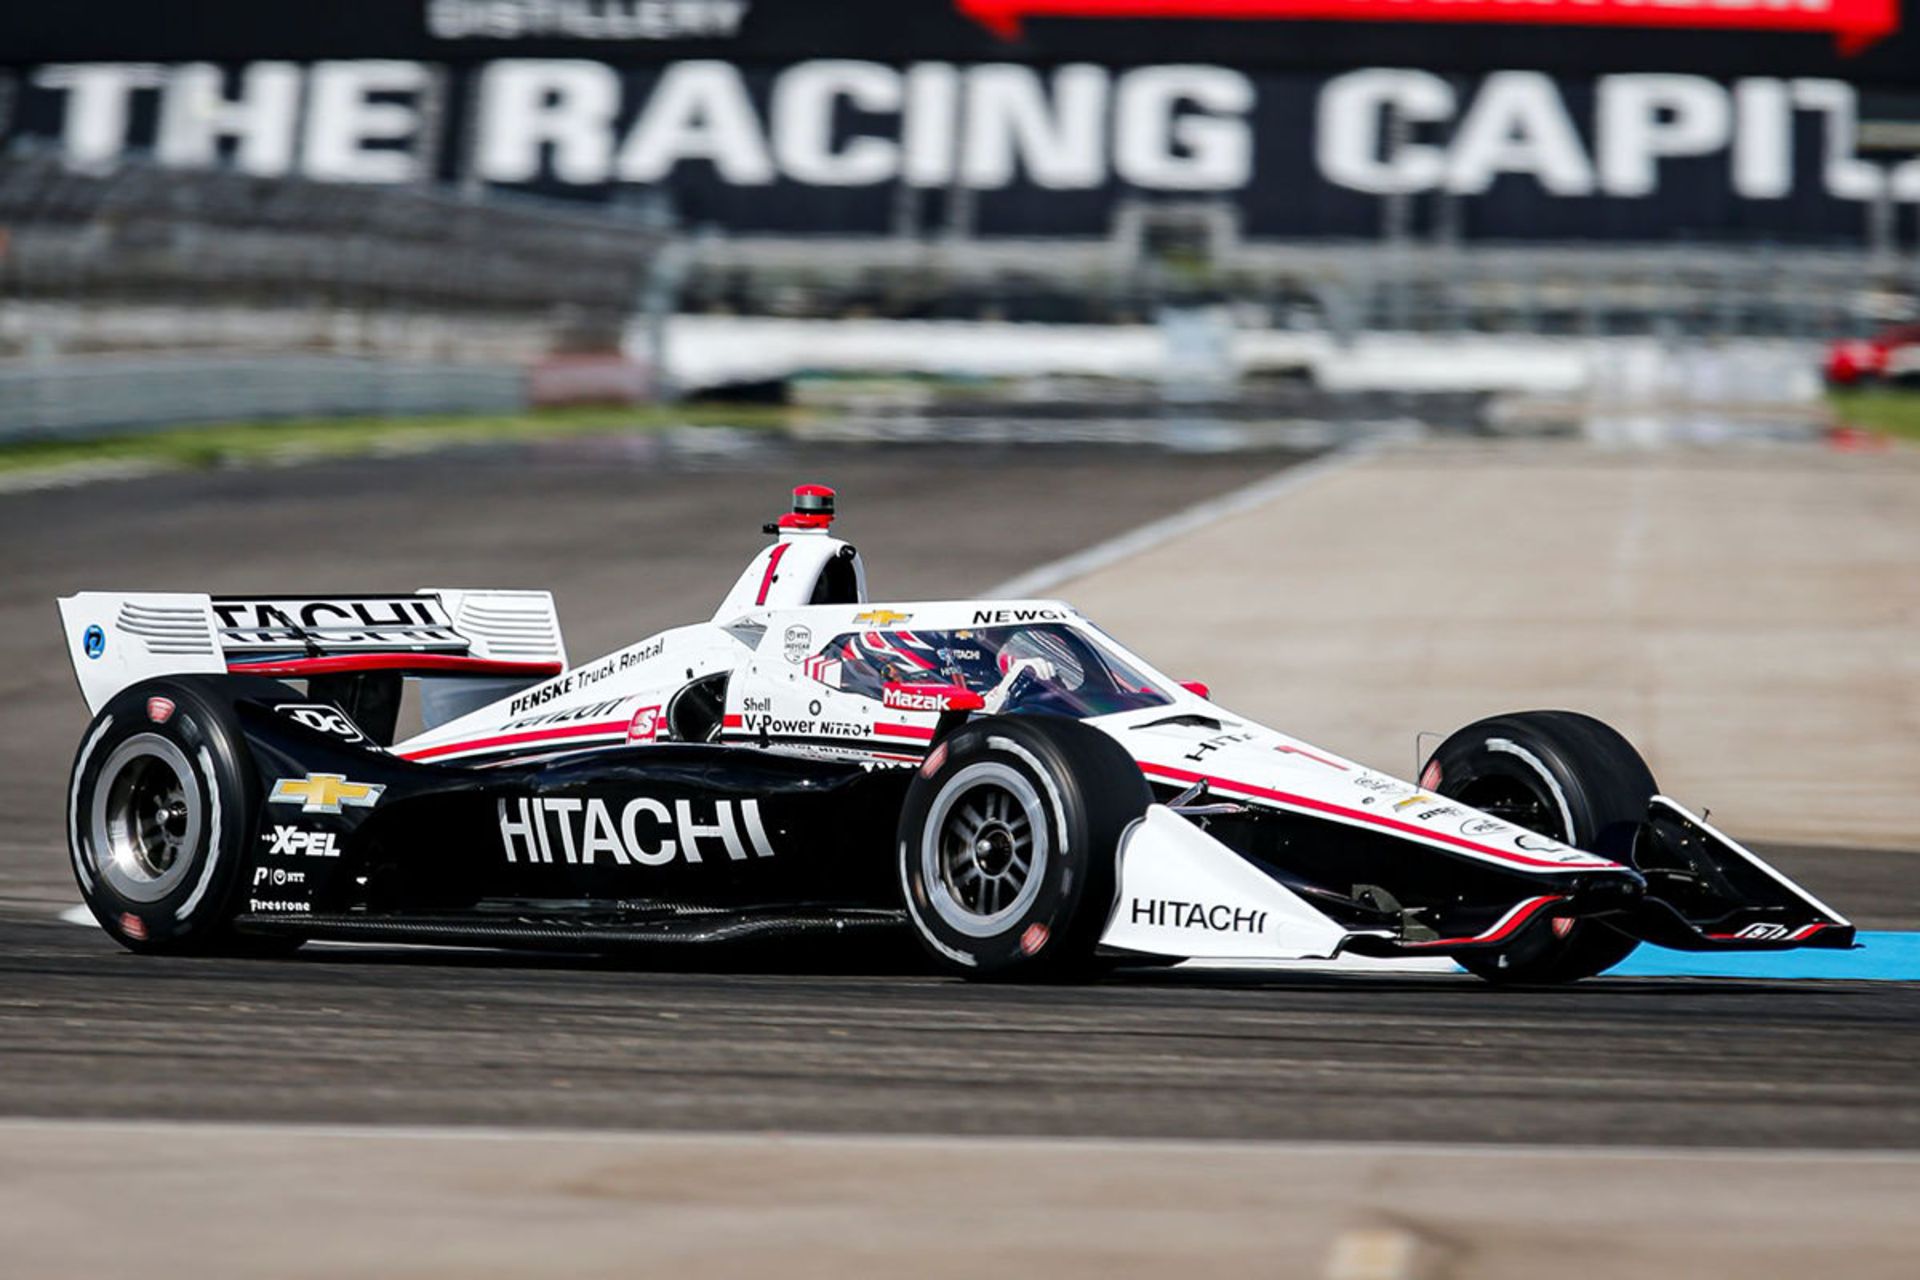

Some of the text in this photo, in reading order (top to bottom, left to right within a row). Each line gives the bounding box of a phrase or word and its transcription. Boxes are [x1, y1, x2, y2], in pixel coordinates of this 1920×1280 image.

[32, 57, 1920, 200] THE RACING CAPIT
[510, 637, 665, 717] PENSKE Truck Rental
[744, 698, 771, 711] Shell
[745, 714, 815, 735] V-Power
[268, 825, 341, 857] XPEL
[499, 797, 775, 865] HITACHI
[249, 898, 311, 912] Firestone
[1131, 897, 1269, 934] HITACHI
